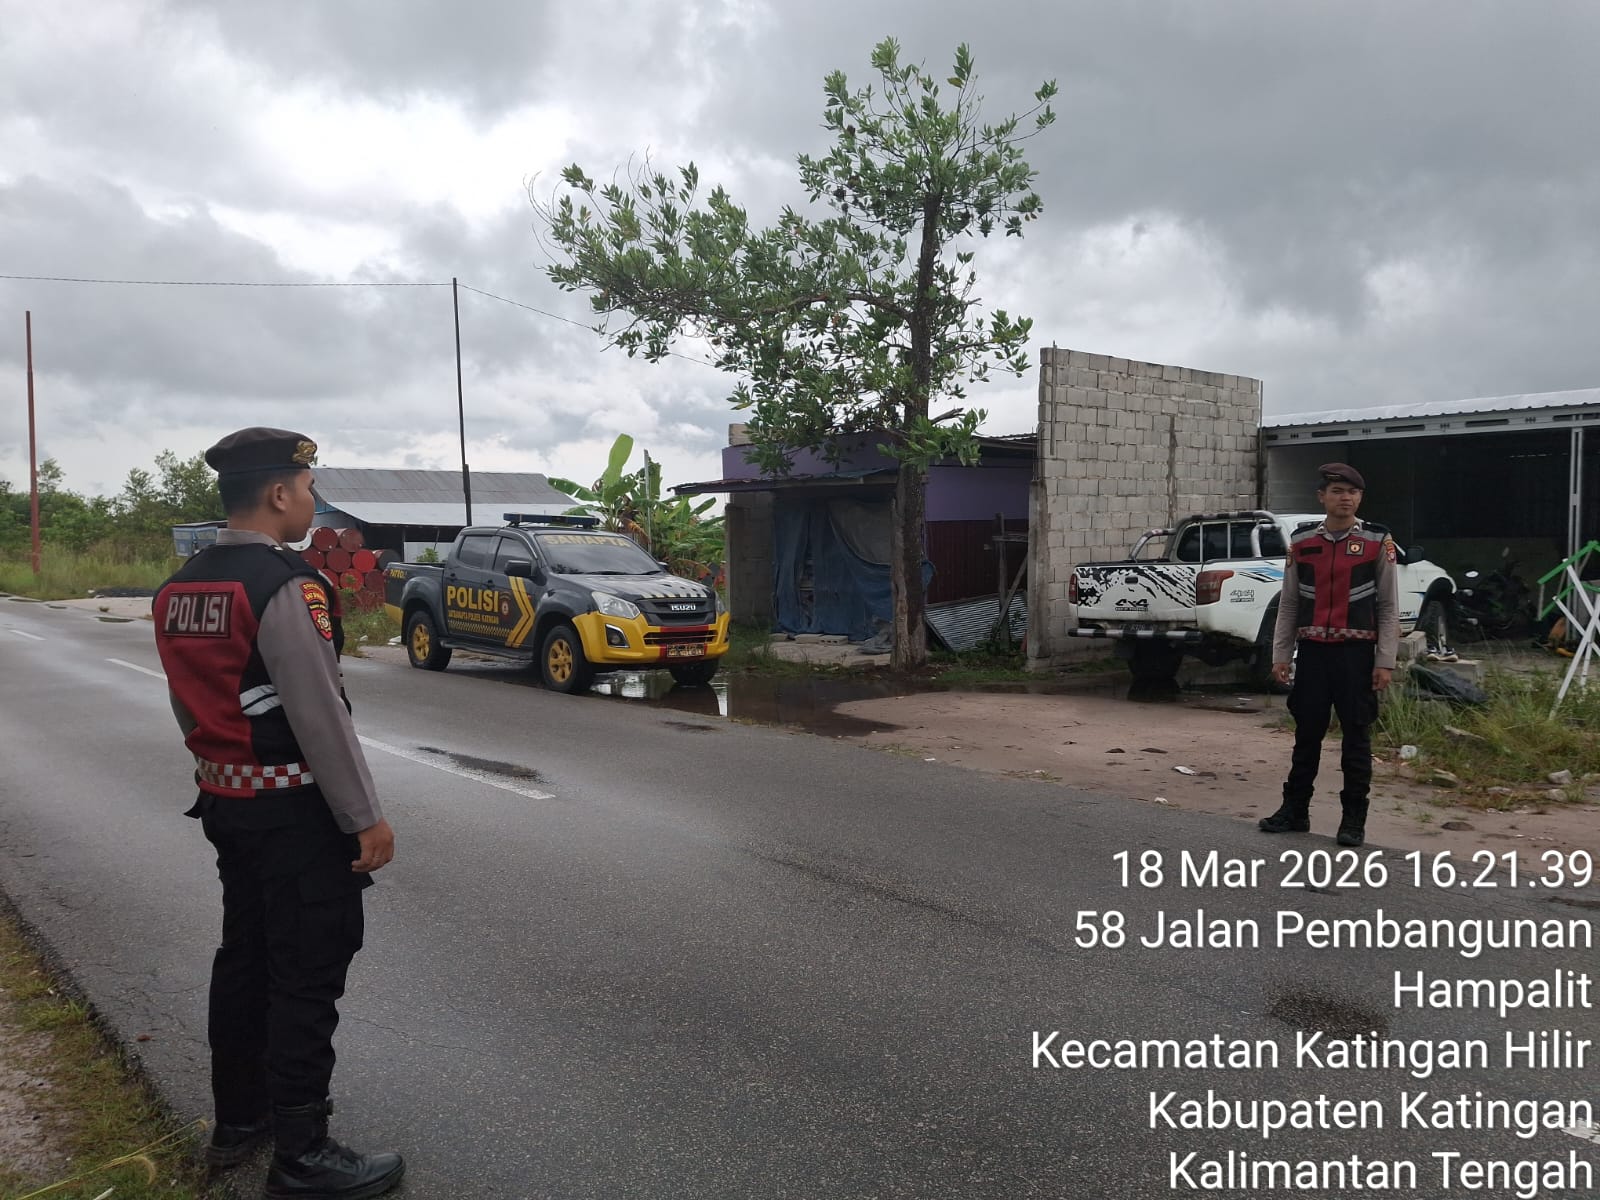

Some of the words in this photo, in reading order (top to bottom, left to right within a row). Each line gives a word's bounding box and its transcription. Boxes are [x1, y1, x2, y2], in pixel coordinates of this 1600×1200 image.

[543, 534, 632, 548] SAMAPTA
[447, 585, 499, 613] POLISI
[671, 603, 697, 611] ISUZU
[164, 595, 228, 633] POLISI
